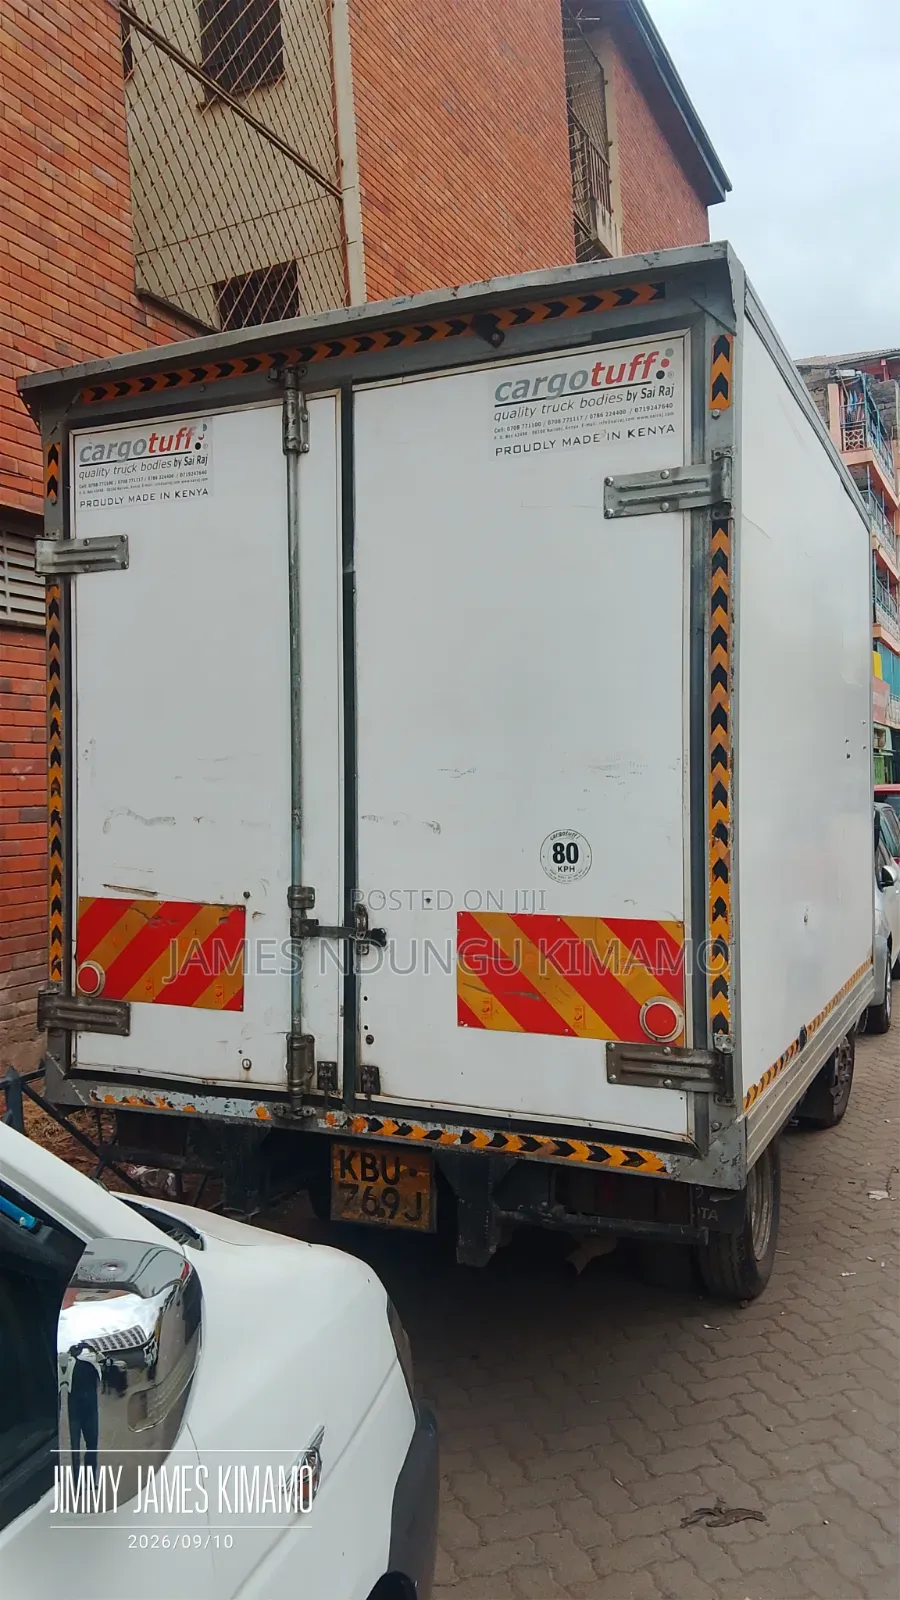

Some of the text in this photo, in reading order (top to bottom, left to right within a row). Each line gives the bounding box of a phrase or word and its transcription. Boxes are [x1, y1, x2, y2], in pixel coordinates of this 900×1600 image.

[494, 351, 660, 402] cargotuff
[494, 383, 675, 423] quality truck bodies by Sai Raj
[79, 426, 197, 463] cargotuff
[495, 424, 675, 456] PROUDLY MADE IN KENYA
[79, 454, 208, 480] quality truck bodies by Sai Raj
[80, 496, 124, 508] PROUDLY
[128, 493, 156, 503] MADE
[175, 488, 208, 498] KENYA
[552, 842, 579, 864] 80
[338, 1149, 400, 1185] KBU
